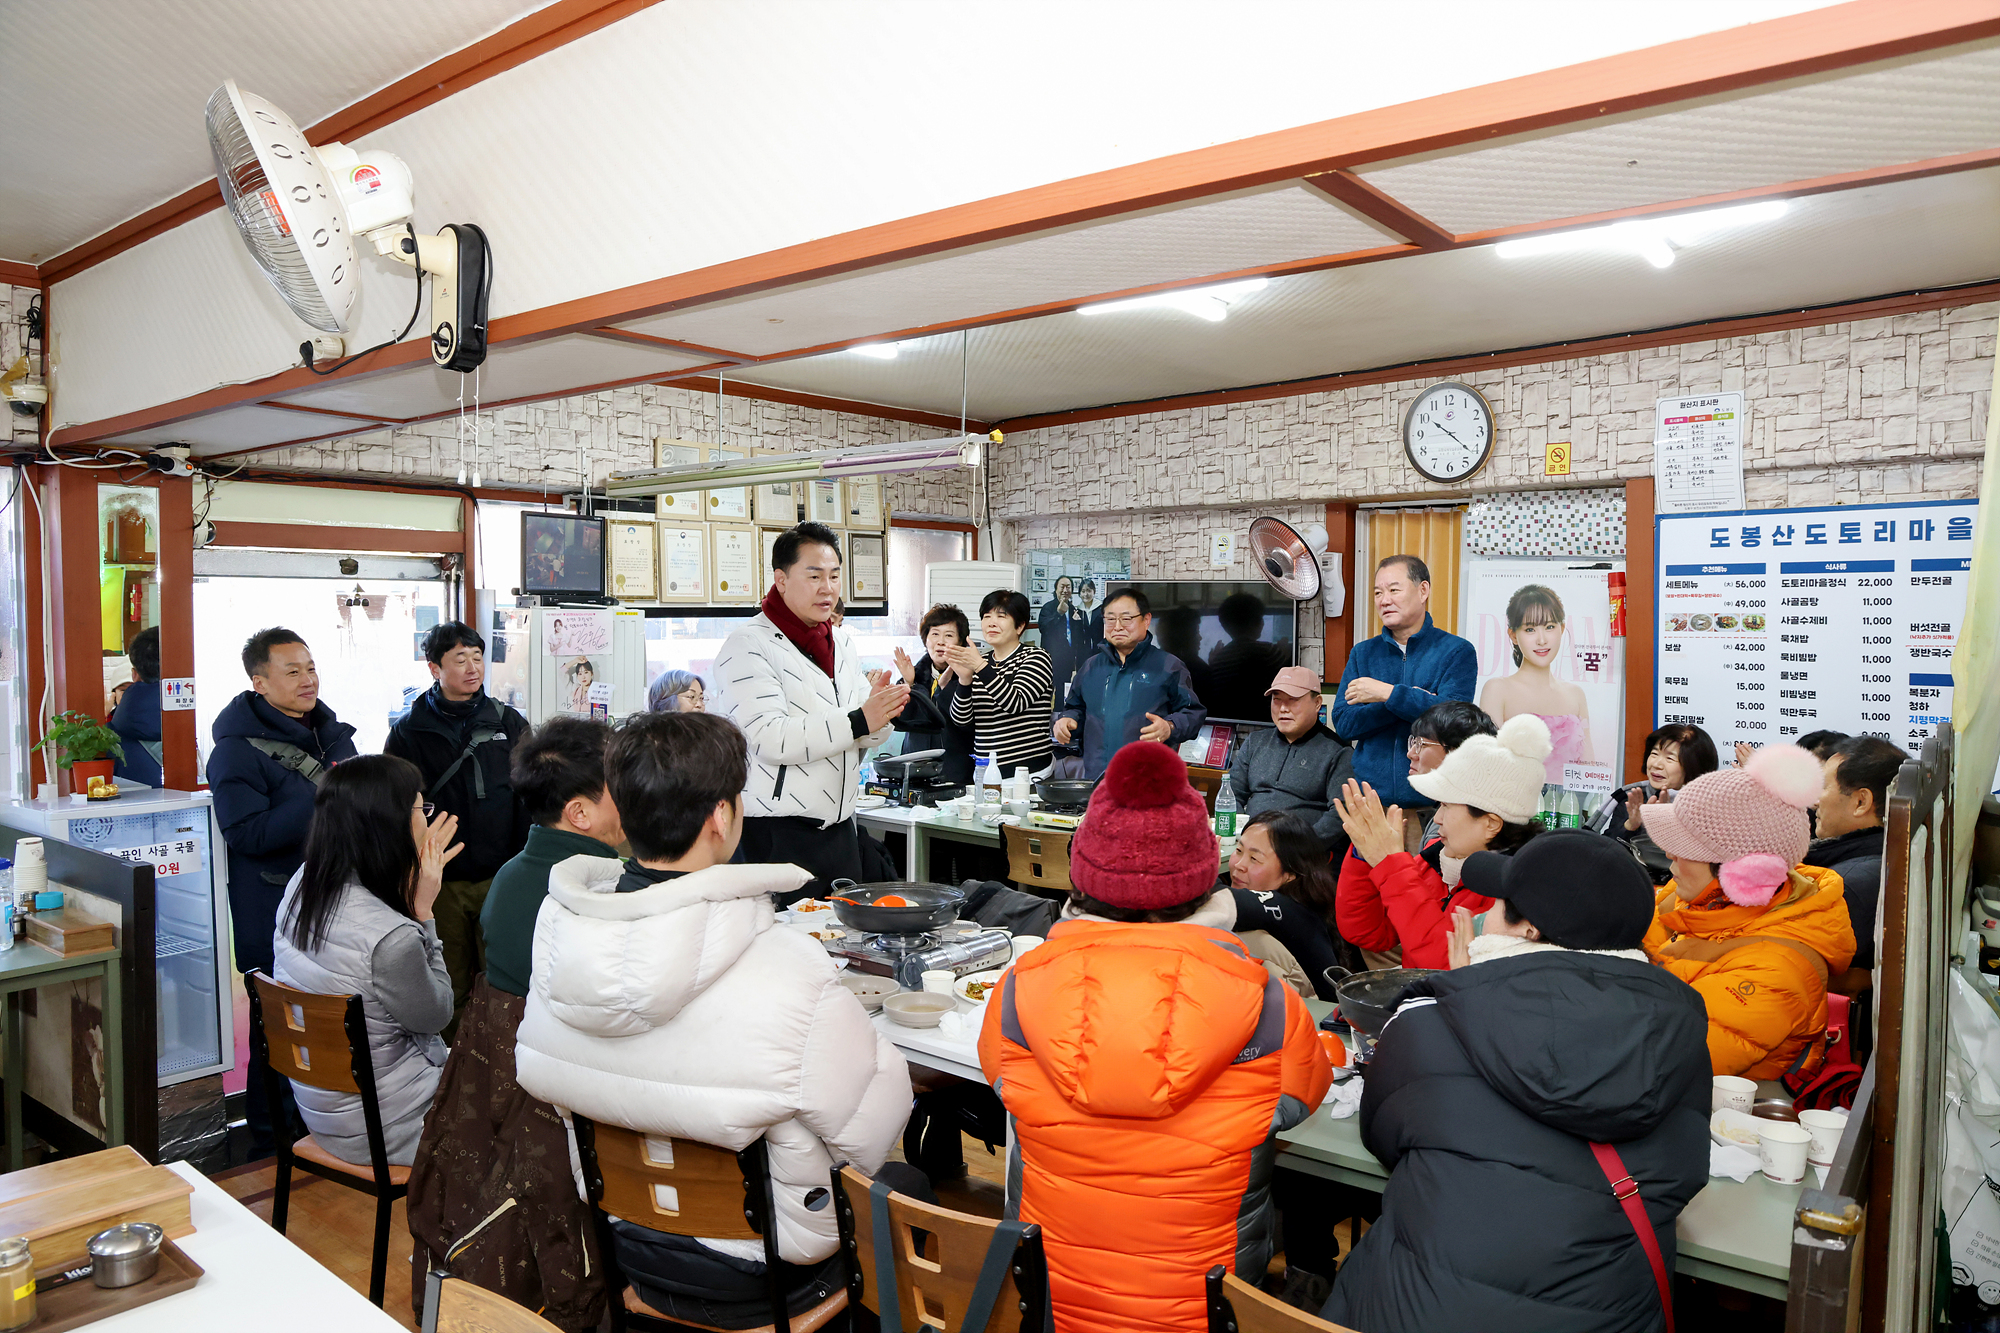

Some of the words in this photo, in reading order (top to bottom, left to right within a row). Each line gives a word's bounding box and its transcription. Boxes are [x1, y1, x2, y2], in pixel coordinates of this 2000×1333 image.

[1444, 394, 1455, 406] 12
[1463, 398, 1468, 409] 1
[1680, 401, 1698, 409] 원산지
[1700, 399, 1719, 407] 표시판
[1430, 400, 1438, 411] 11
[1419, 413, 1430, 424] 10
[1472, 409, 1480, 420] 2
[1417, 429, 1424, 440] 9
[1475, 426, 1484, 438] 3
[1419, 446, 1427, 456] 8
[1472, 443, 1480, 454] 4
[1431, 458, 1438, 469] 7
[1446, 461, 1453, 473] 6
[1461, 457, 1469, 468] 5
[1548, 464, 1566, 472] 금연
[1825, 563, 1847, 571] 식사류
[1665, 581, 1698, 589] 세트메뉴
[1735, 580, 1766, 588] 56,000
[1781, 578, 1847, 588] 도토리마을정식
[1858, 578, 1893, 587] 22,000
[1911, 576, 1952, 586] 만두전골
[1735, 600, 1766, 608] 49,000
[1781, 598, 1819, 606] 사골곰탕
[1863, 598, 1892, 606] 11,000
[1781, 616, 1828, 625] 사골수제비
[1863, 617, 1892, 626] 11,000
[1910, 623, 1951, 632] 버섯전골
[1781, 635, 1809, 643] 묵채밥
[1862, 636, 1892, 645] 11,000
[1665, 644, 1681, 652] 보쌈
[1734, 644, 1765, 652] 42,000
[1780, 653, 1817, 662] 묵비빔밥
[1910, 648, 1952, 658] 쟁반국수
[1862, 655, 1891, 664] 11,000
[1734, 663, 1765, 671] 34,000
[1780, 671, 1808, 681] 물냉면
[1862, 674, 1891, 683] 11,000
[1665, 677, 1688, 686] 묵무침
[1736, 682, 1765, 691] 15,000
[1780, 690, 1817, 700] 비빔냉면
[1862, 693, 1891, 702] 11,000
[1909, 688, 1940, 698] 복분자
[1665, 696, 1688, 705] 빈대떡
[1736, 702, 1765, 711] 15,000
[1909, 701, 1930, 711] 청하
[1780, 708, 1817, 718] 떡만두국
[1861, 712, 1891, 721] 11,000
[1735, 720, 1767, 730] 20,000
[1780, 726, 1798, 736] 만두
[1908, 729, 1929, 738] 소주
[1565, 769, 1582, 780] 티켓
[148, 845, 169, 857] 사골
[174, 841, 195, 854] 국물
[1725, 986, 1748, 1006] EXPERT
